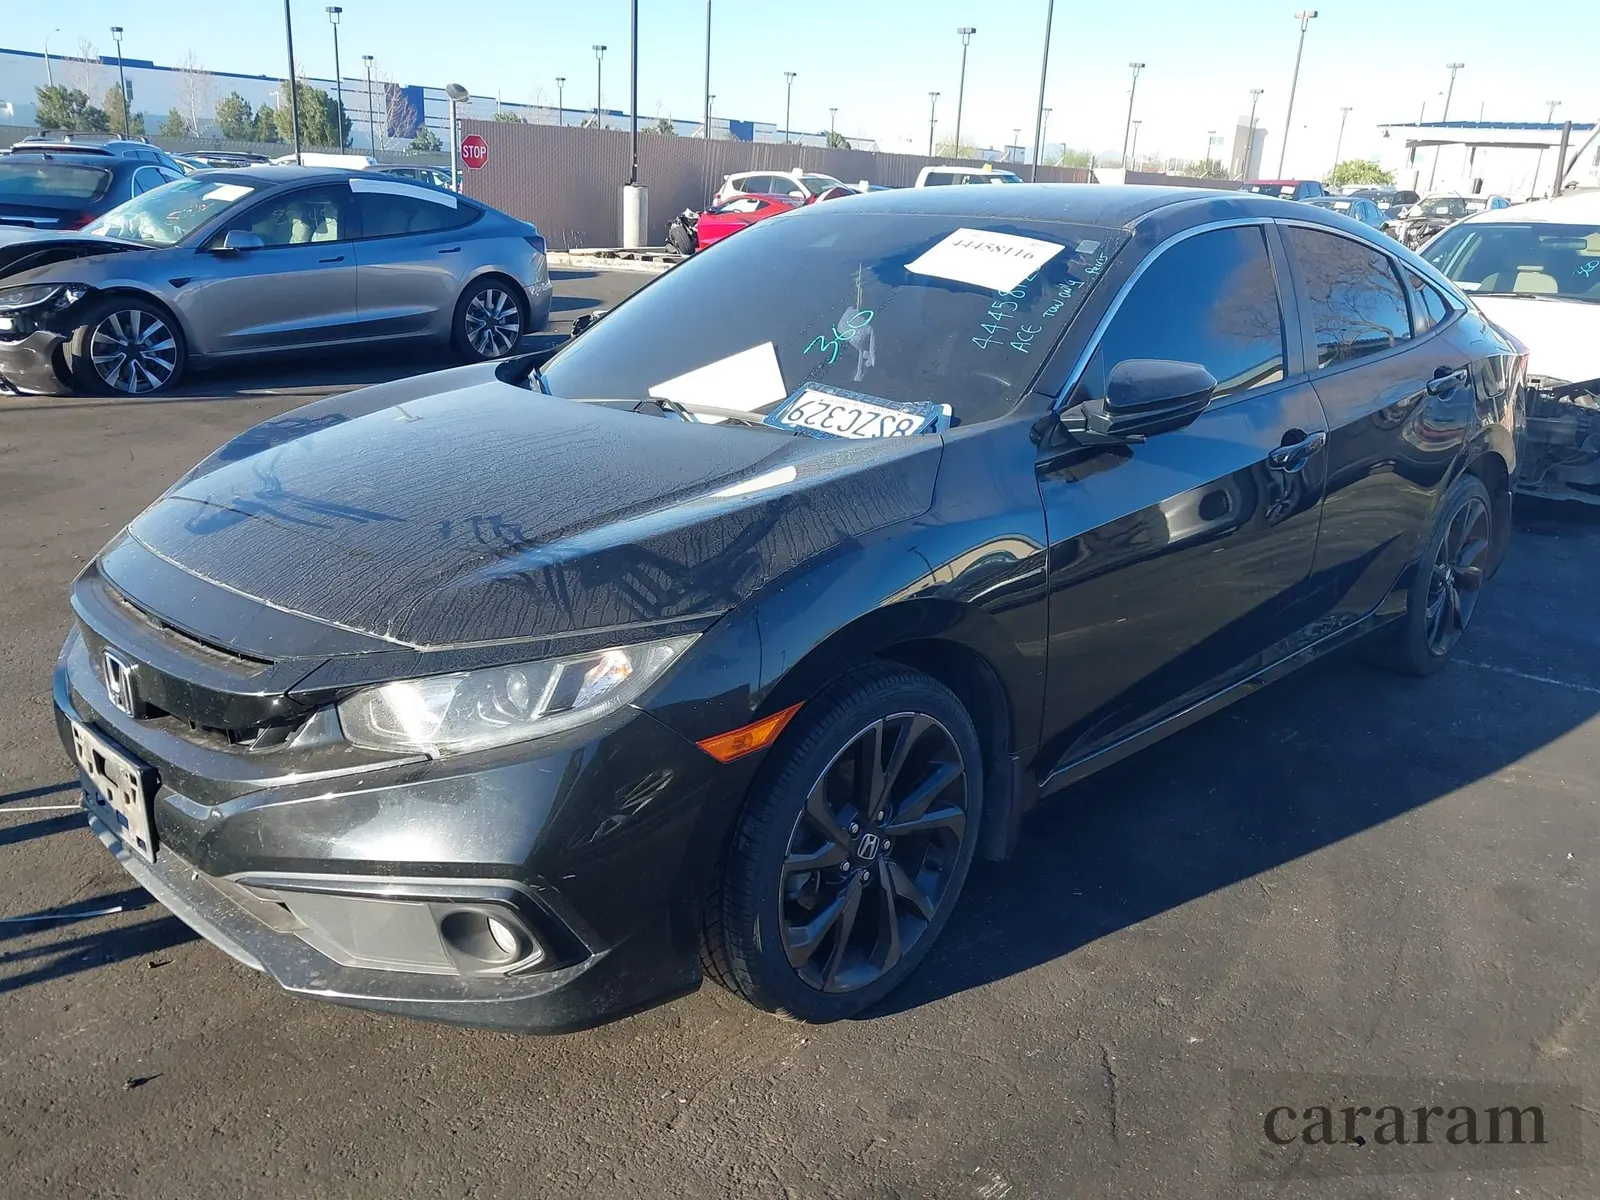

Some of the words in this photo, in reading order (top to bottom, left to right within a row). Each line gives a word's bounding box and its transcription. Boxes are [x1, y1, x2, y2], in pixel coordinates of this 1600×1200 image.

[463, 145, 487, 159] STOP
[803, 310, 874, 364] 360
[1010, 324, 1043, 354] ACE
